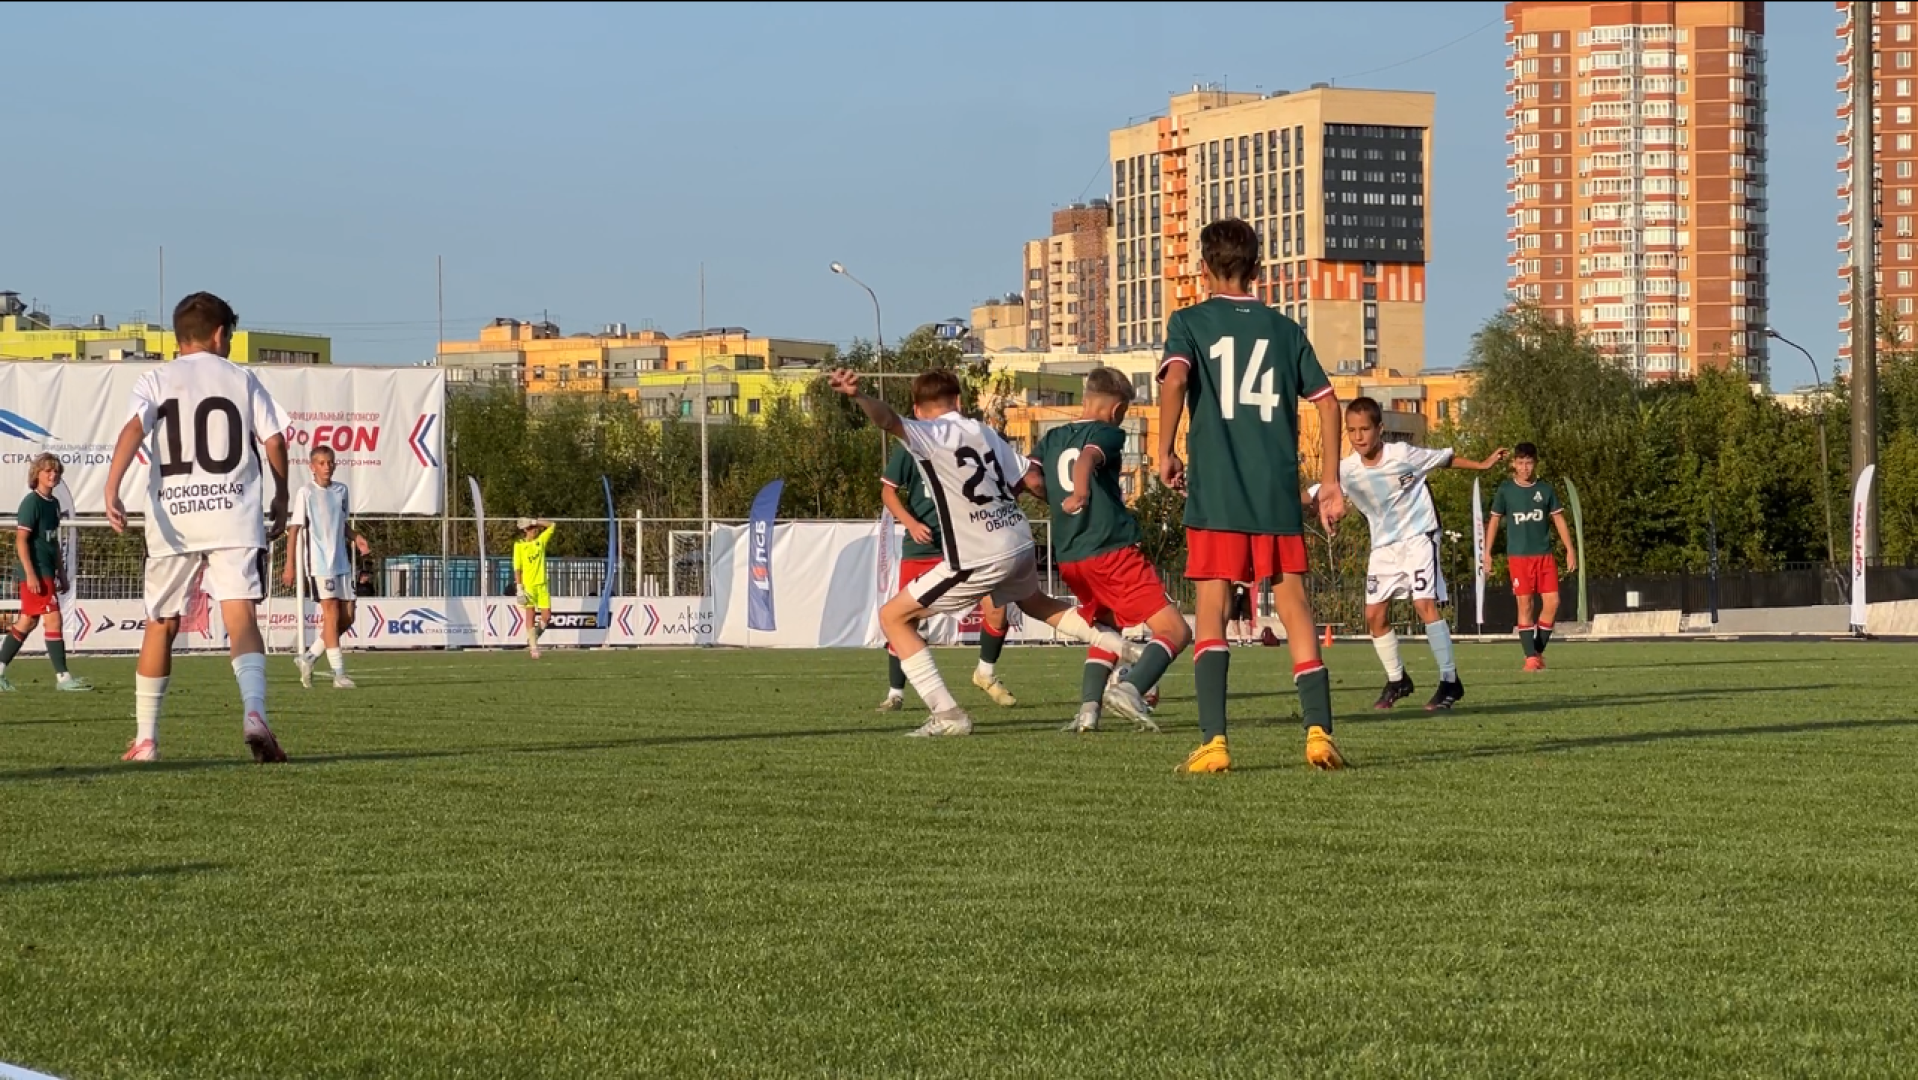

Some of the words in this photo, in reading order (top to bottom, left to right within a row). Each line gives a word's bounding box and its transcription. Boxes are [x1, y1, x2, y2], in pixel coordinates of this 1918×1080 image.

[1210, 336, 1280, 422] 14
[157, 396, 243, 478] 10
[312, 425, 380, 452] FON
[169, 497, 234, 516] ОБЛАСТЬ
[755, 520, 767, 563] ПСБ
[1414, 569, 1427, 591] 5
[677, 611, 714, 620] AKINF
[387, 620, 424, 634] ВСК
[662, 624, 713, 635] MAKO
